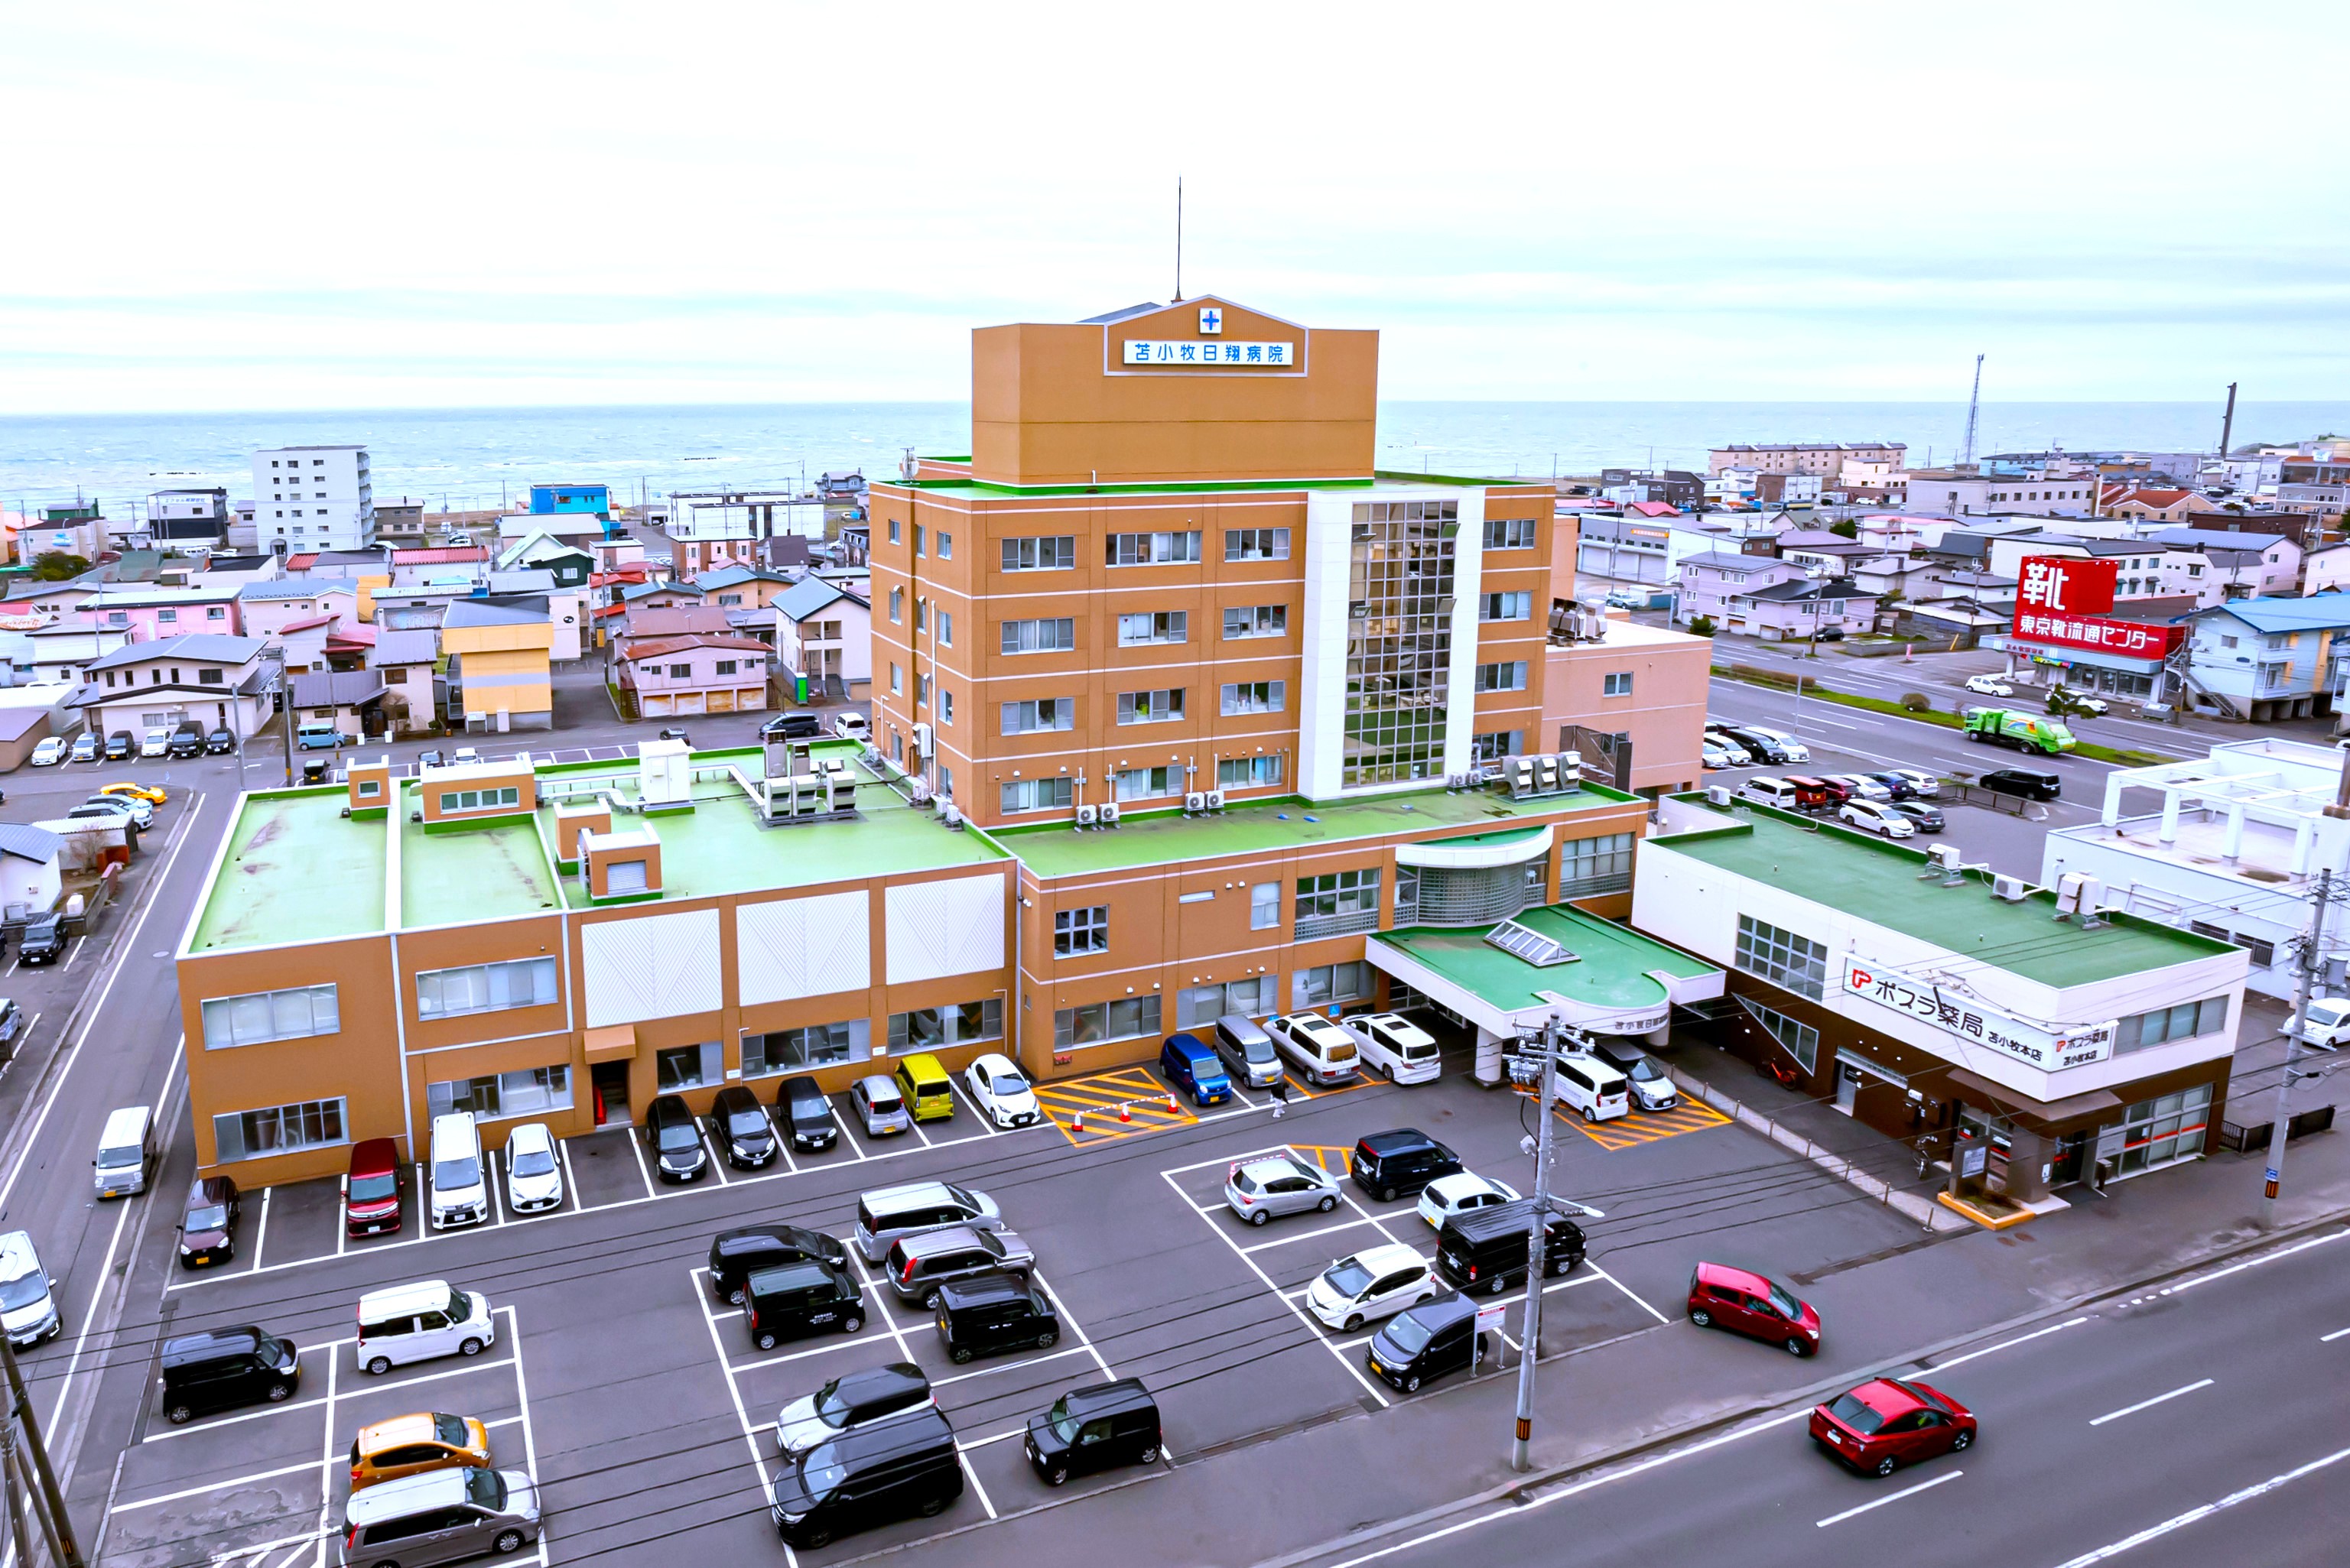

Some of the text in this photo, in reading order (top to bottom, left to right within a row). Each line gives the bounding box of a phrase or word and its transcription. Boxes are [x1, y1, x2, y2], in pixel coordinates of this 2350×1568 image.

[1135, 342, 1283, 362] 苫小牧日翔病院
[2022, 563, 2069, 611] 靴
[2020, 615, 2160, 650] 東京靴流通センター
[1875, 981, 2043, 1062] ポプラ薬局 苫小牧本店
